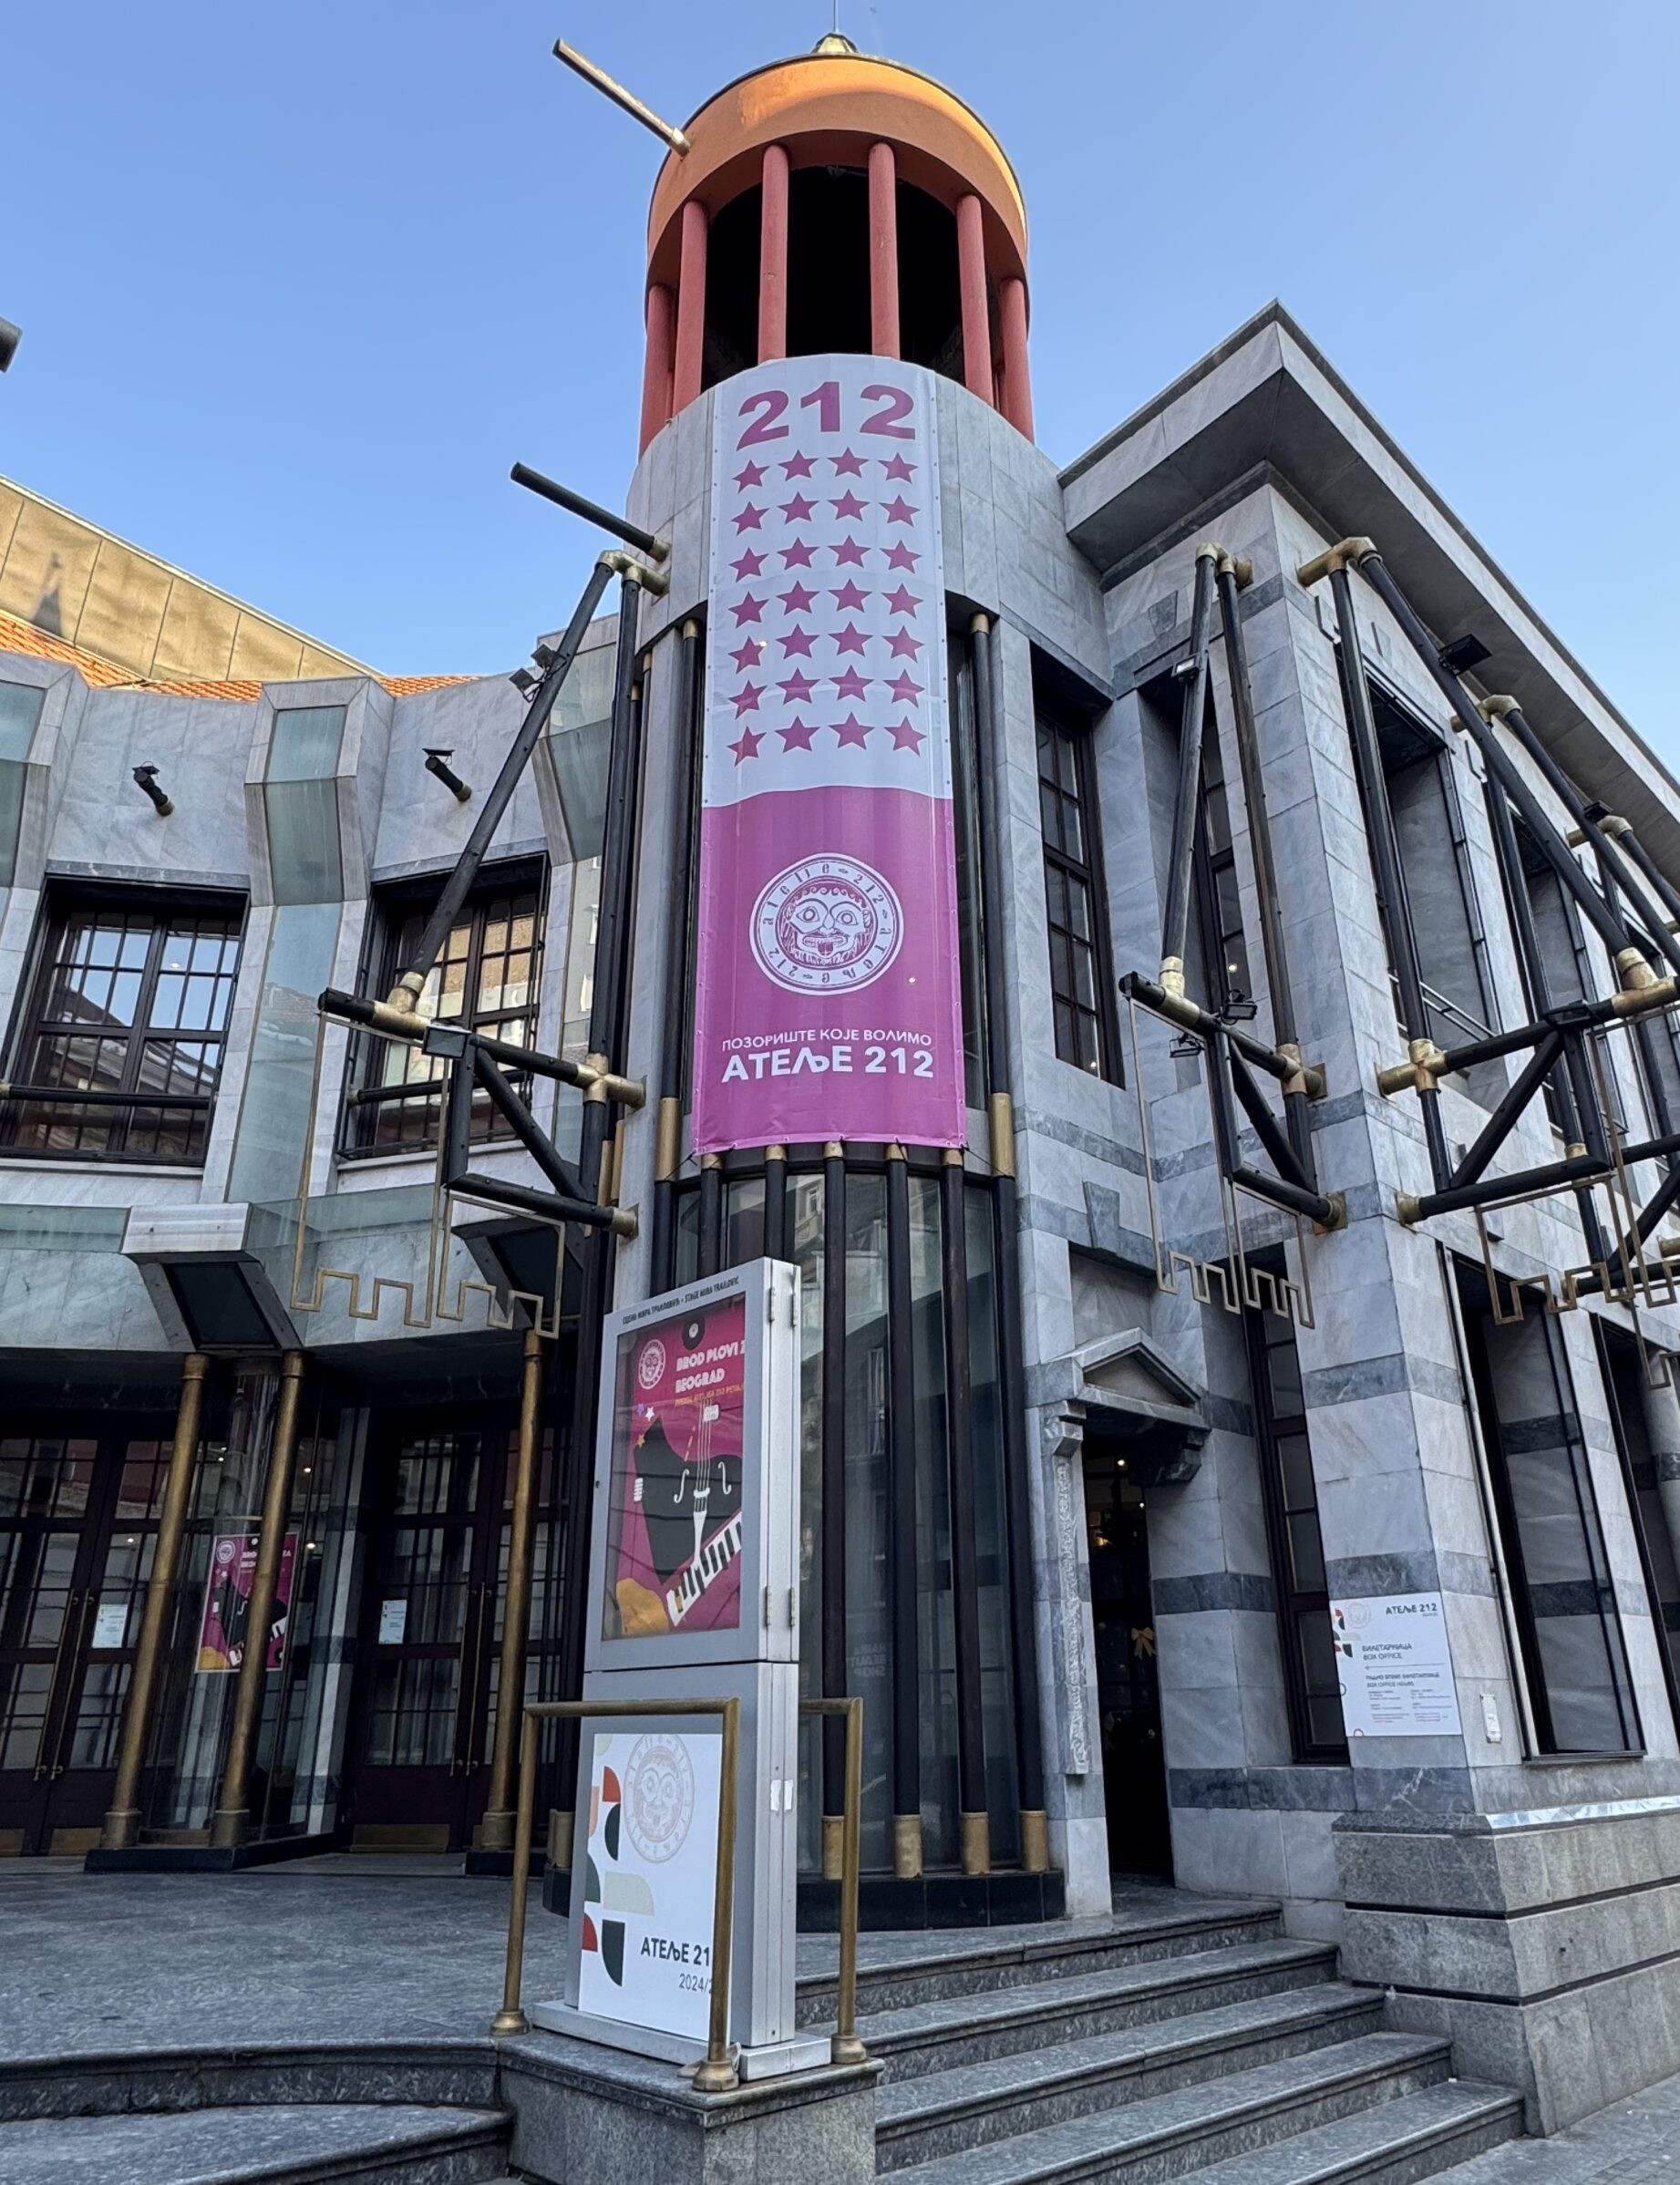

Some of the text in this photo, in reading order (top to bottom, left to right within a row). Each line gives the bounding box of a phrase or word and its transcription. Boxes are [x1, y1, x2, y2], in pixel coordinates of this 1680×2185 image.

[737, 381, 916, 451] 212
[722, 1028, 933, 1052] ПОЗОРИШТЕ КОЈЕ ВОЛИМО
[721, 1045, 934, 1083] АТЕЉЕ 212
[675, 1352, 705, 1371] BROD
[706, 1341, 738, 1364] PLOVI
[675, 1367, 726, 1394] BEOGRAD
[1419, 1603, 1438, 1613] 212
[1377, 1652, 1403, 1660] OFFICE
[640, 1936, 710, 1966] АТЕЉЕ 21
